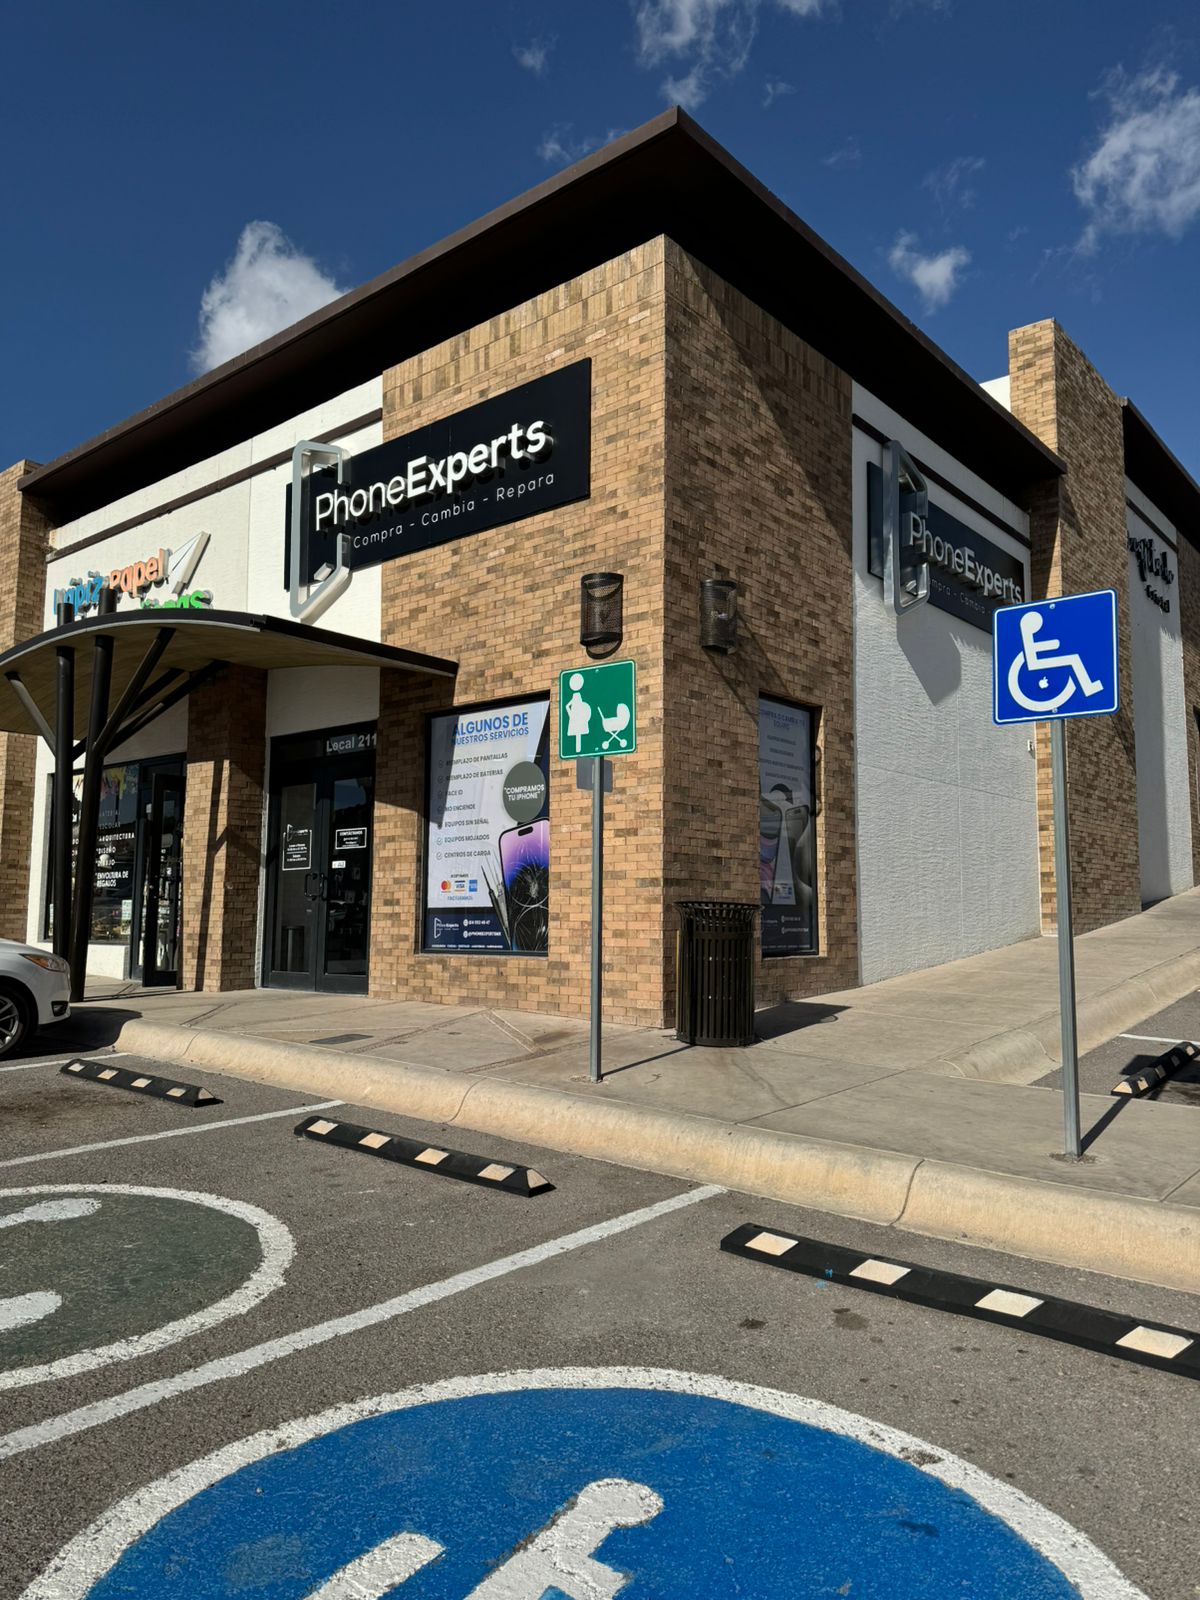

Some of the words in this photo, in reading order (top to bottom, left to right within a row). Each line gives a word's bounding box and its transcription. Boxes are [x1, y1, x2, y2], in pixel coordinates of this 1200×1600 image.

[316, 420, 548, 532] PhoneExperts
[353, 524, 403, 549] Compra
[421, 499, 475, 527] Cambia
[496, 472, 555, 502] Repara
[908, 512, 1022, 604] PhoneExperts
[326, 737, 355, 752] Local
[453, 715, 509, 736] ALGUNOS
[513, 712, 529, 727] DE
[490, 727, 529, 740] SERVICIOS
